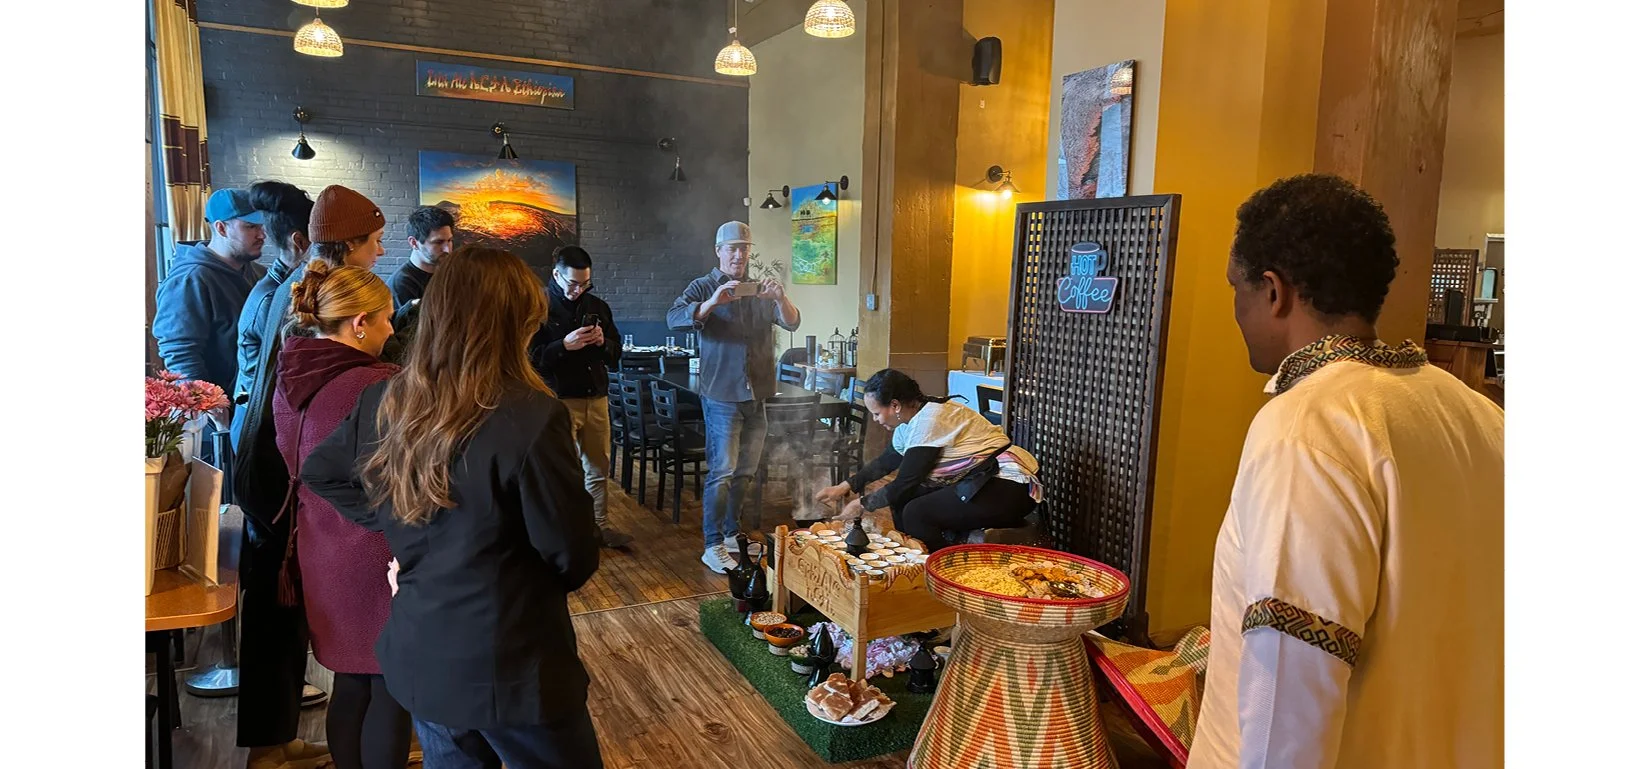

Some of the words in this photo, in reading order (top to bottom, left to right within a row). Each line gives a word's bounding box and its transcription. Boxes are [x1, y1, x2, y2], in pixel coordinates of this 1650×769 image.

[513, 77, 566, 105] Ethiopian
[1071, 254, 1097, 275] HOT
[1058, 277, 1112, 310] Coffee
